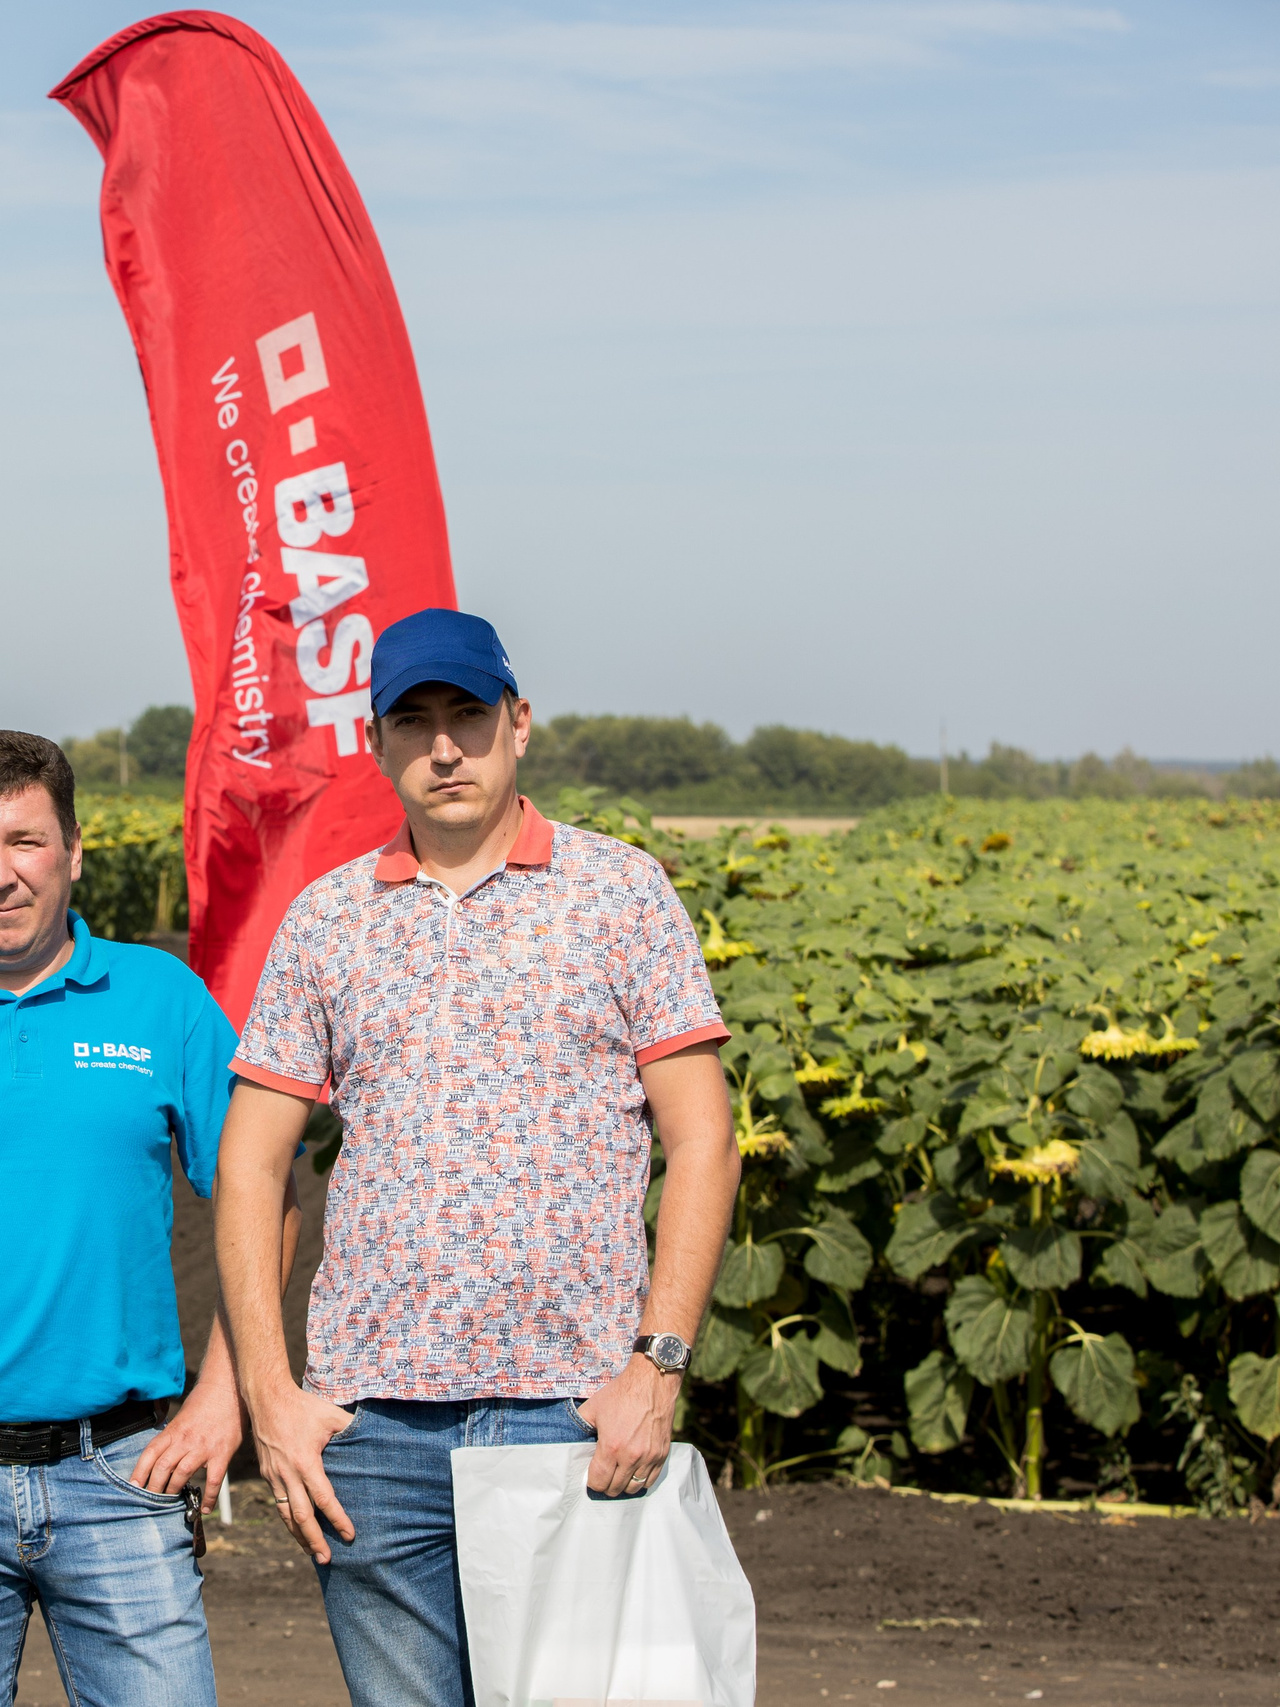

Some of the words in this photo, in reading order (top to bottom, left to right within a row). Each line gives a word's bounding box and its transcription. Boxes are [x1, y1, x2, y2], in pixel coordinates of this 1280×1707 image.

[211, 356, 243, 429] We
[232, 572, 273, 769] chemistry
[274, 461, 375, 757] BASF
[74, 1060, 89, 1069] We
[90, 1061, 117, 1069] create
[118, 1062, 154, 1077] chemistry
[102, 1042, 152, 1062] BASF
